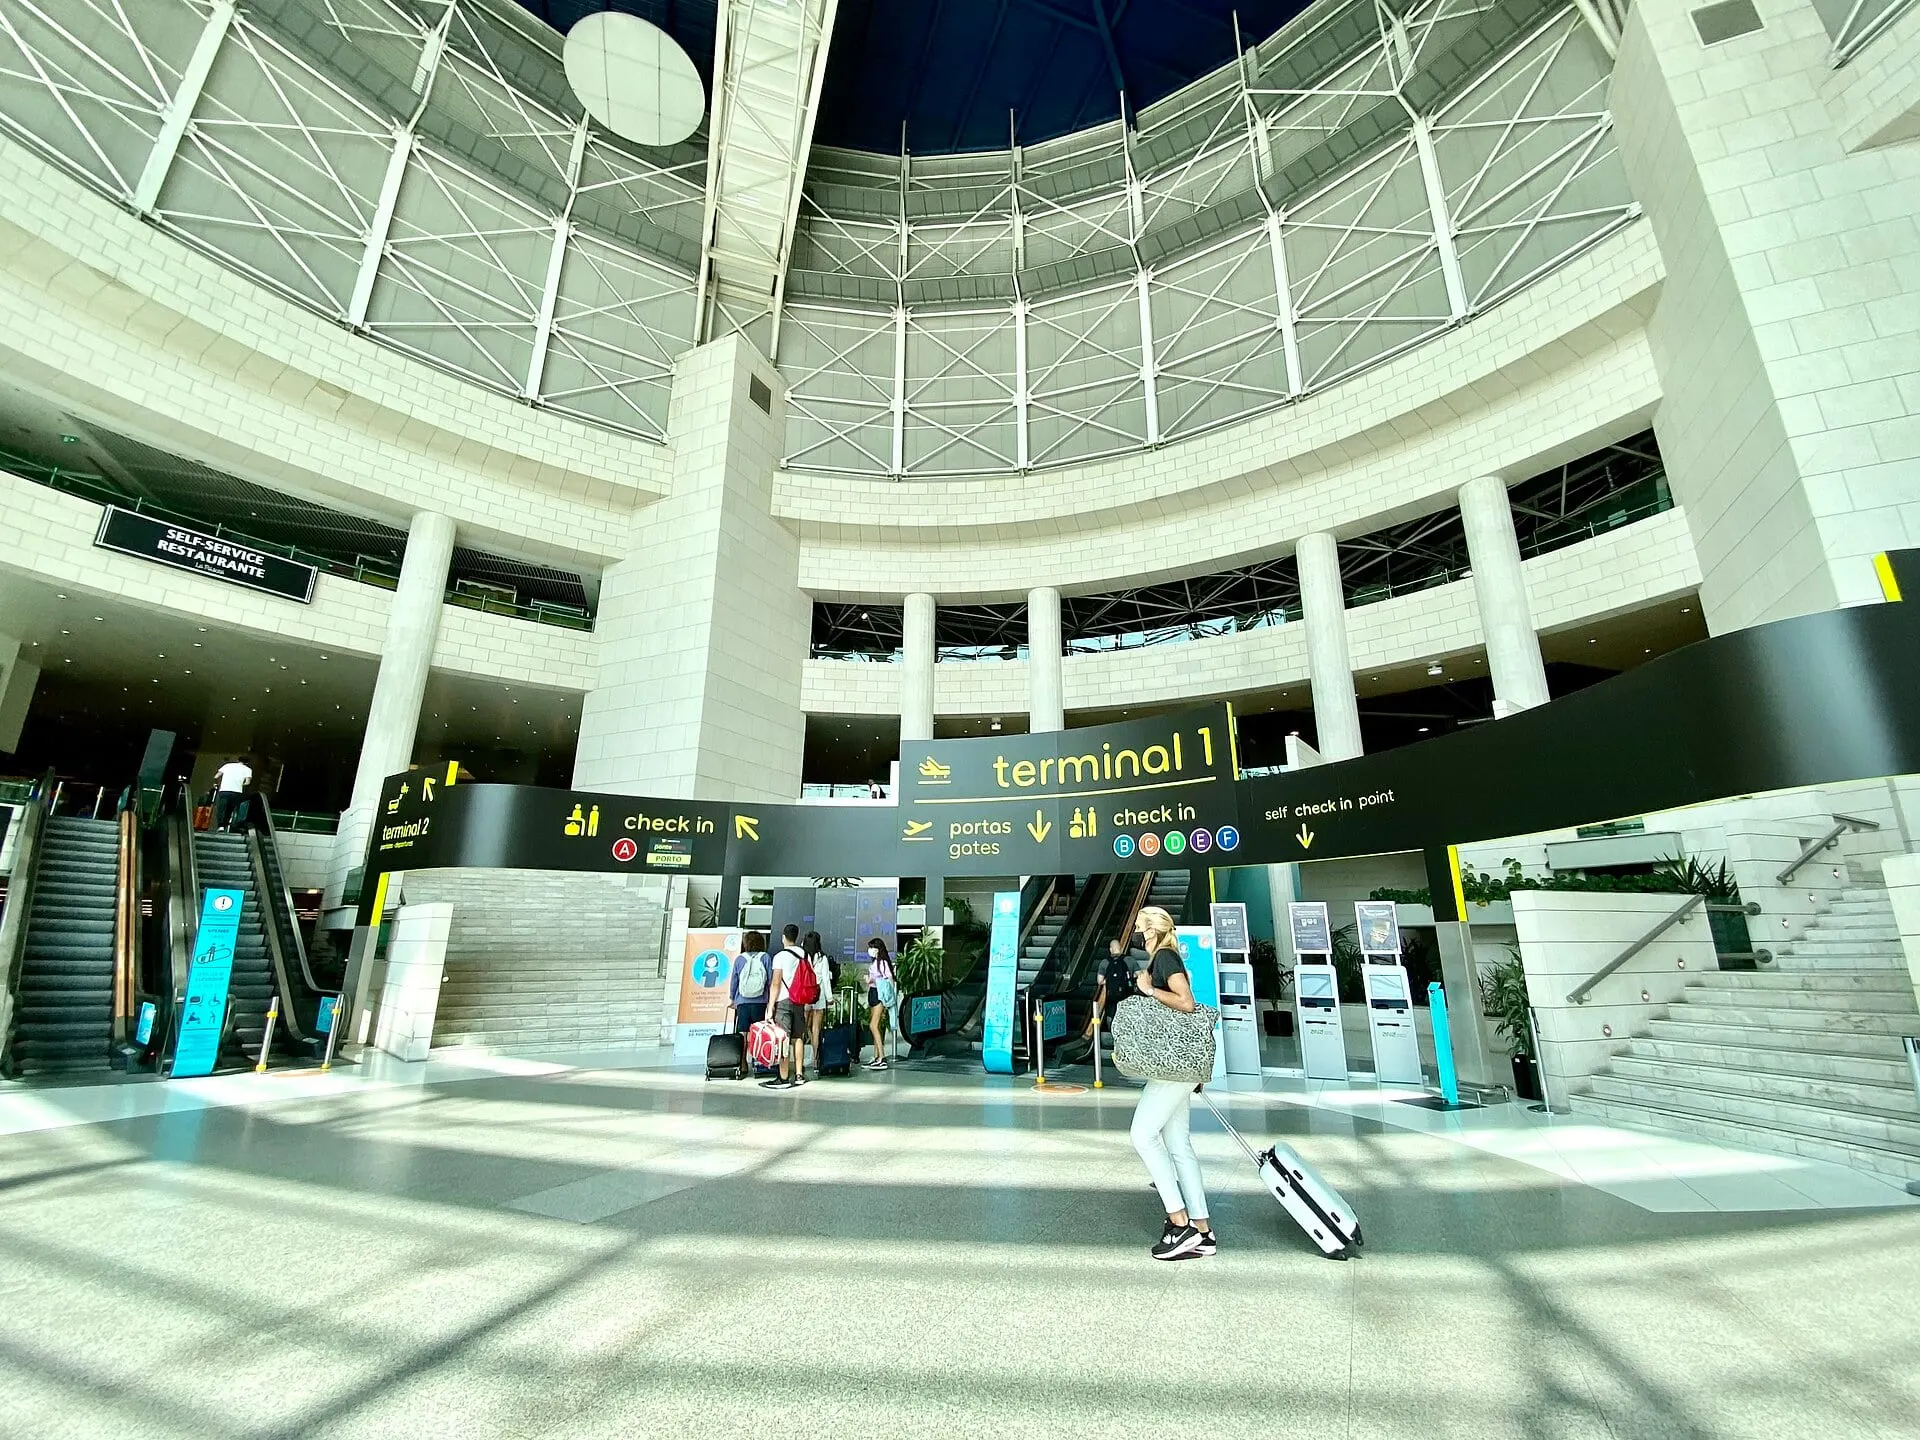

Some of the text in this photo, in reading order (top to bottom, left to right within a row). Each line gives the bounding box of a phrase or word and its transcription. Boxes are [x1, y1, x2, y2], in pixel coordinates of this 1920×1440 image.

[157, 539, 266, 579] RESTAURANTE
[166, 528, 265, 566] SELF-SERVICE
[992, 726, 1213, 788] terminal 1
[1113, 802, 1195, 827] check in
[1264, 789, 1395, 821] self check in point
[383, 817, 429, 840] terminal 2
[624, 813, 714, 834] check in
[949, 818, 1012, 838] portas
[655, 855, 682, 863] PORTO
[949, 840, 1001, 860] gates
